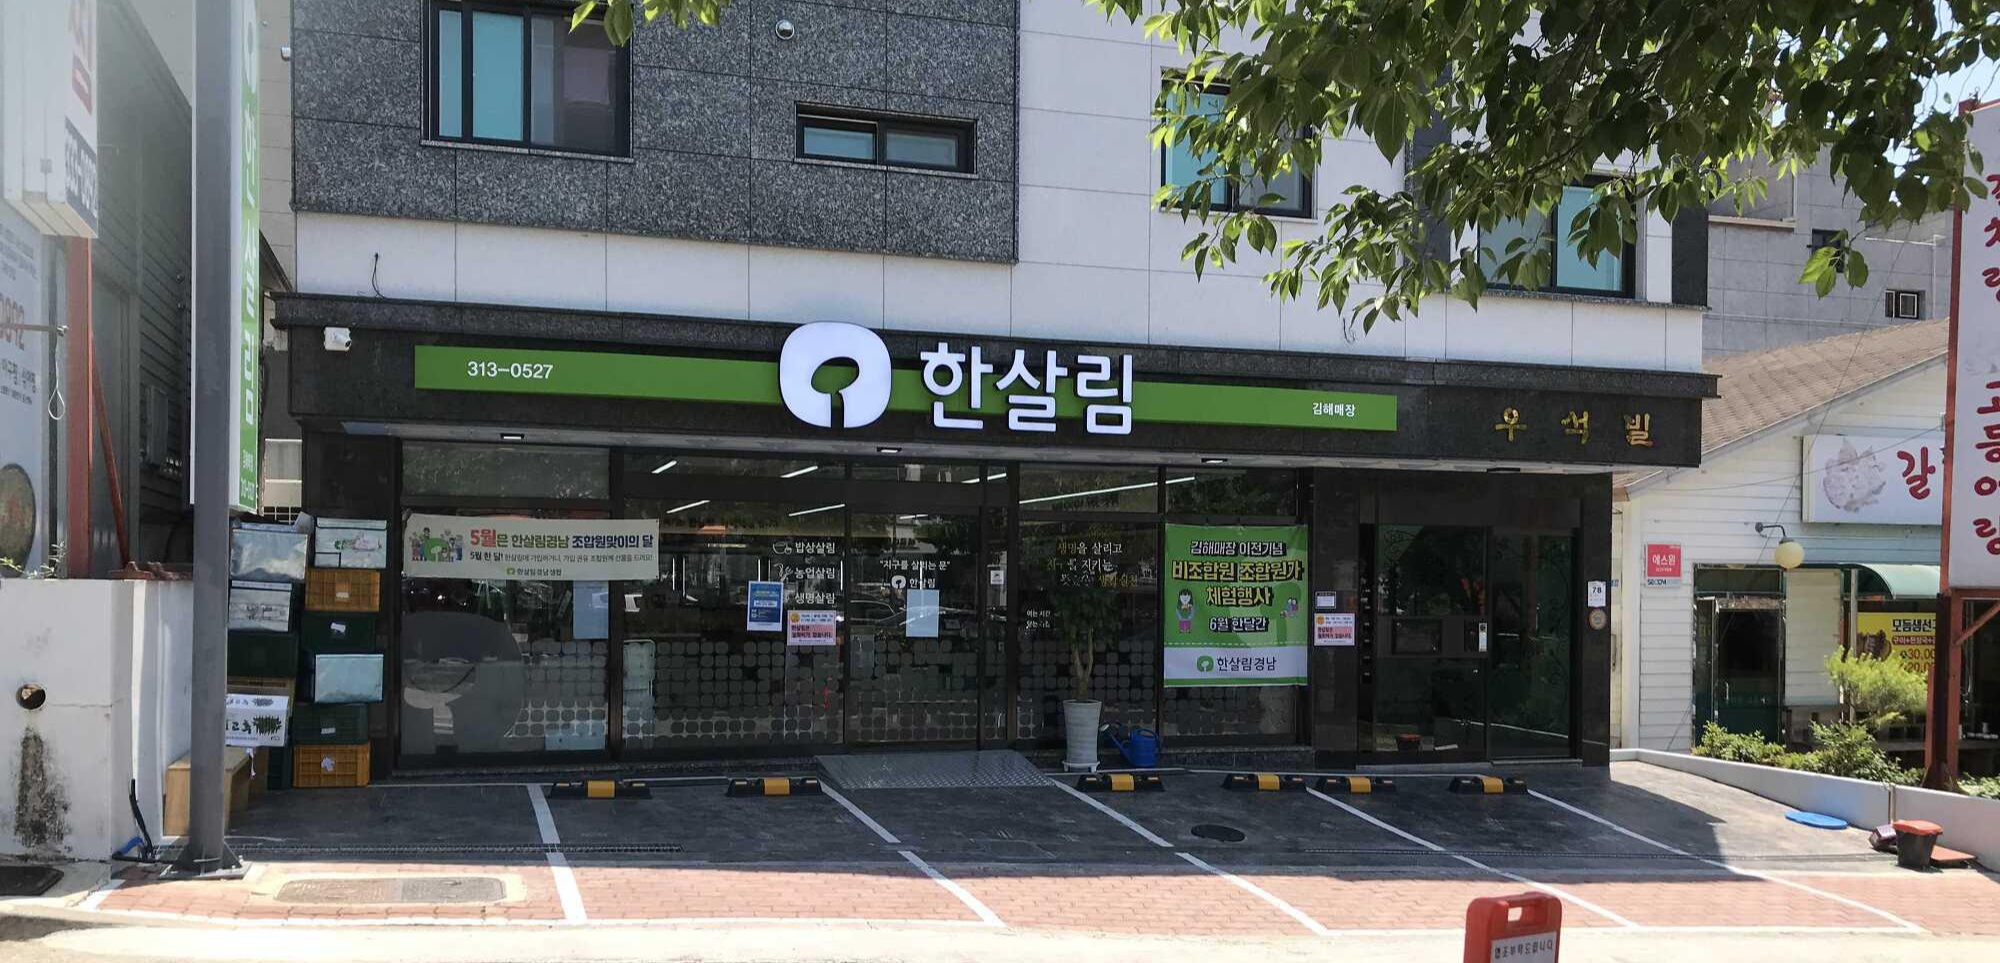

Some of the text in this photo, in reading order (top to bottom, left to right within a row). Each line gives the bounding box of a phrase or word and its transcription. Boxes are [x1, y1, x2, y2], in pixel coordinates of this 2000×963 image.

[466, 360, 554, 380] 313-0527
[919, 341, 1134, 436] 한살림
[1311, 401, 1357, 419] 김해매장
[1896, 446, 1936, 500] 갈
[470, 528, 653, 549] 5월은 한살림경남 조합원맞이의 달
[795, 541, 836, 554] 밥상살림
[1091, 541, 1123, 556] 살리고
[1190, 541, 1285, 556] 김해매장 이전기념
[470, 551, 482, 561] 5월
[484, 552, 491, 561] 한
[1652, 554, 1676, 566] 에스원
[1081, 558, 1115, 572] 지키는
[1172, 560, 1302, 581] 비조합원 조합원가
[794, 566, 836, 580] 농업살림
[1206, 586, 1271, 606] 체험행사
[1592, 586, 1602, 594] 78
[794, 592, 836, 605] 생명살림
[1209, 617, 1268, 632] 6월 한달간
[1892, 618, 1935, 632] 모듬생선
[1217, 656, 1277, 672] 한살림경남
